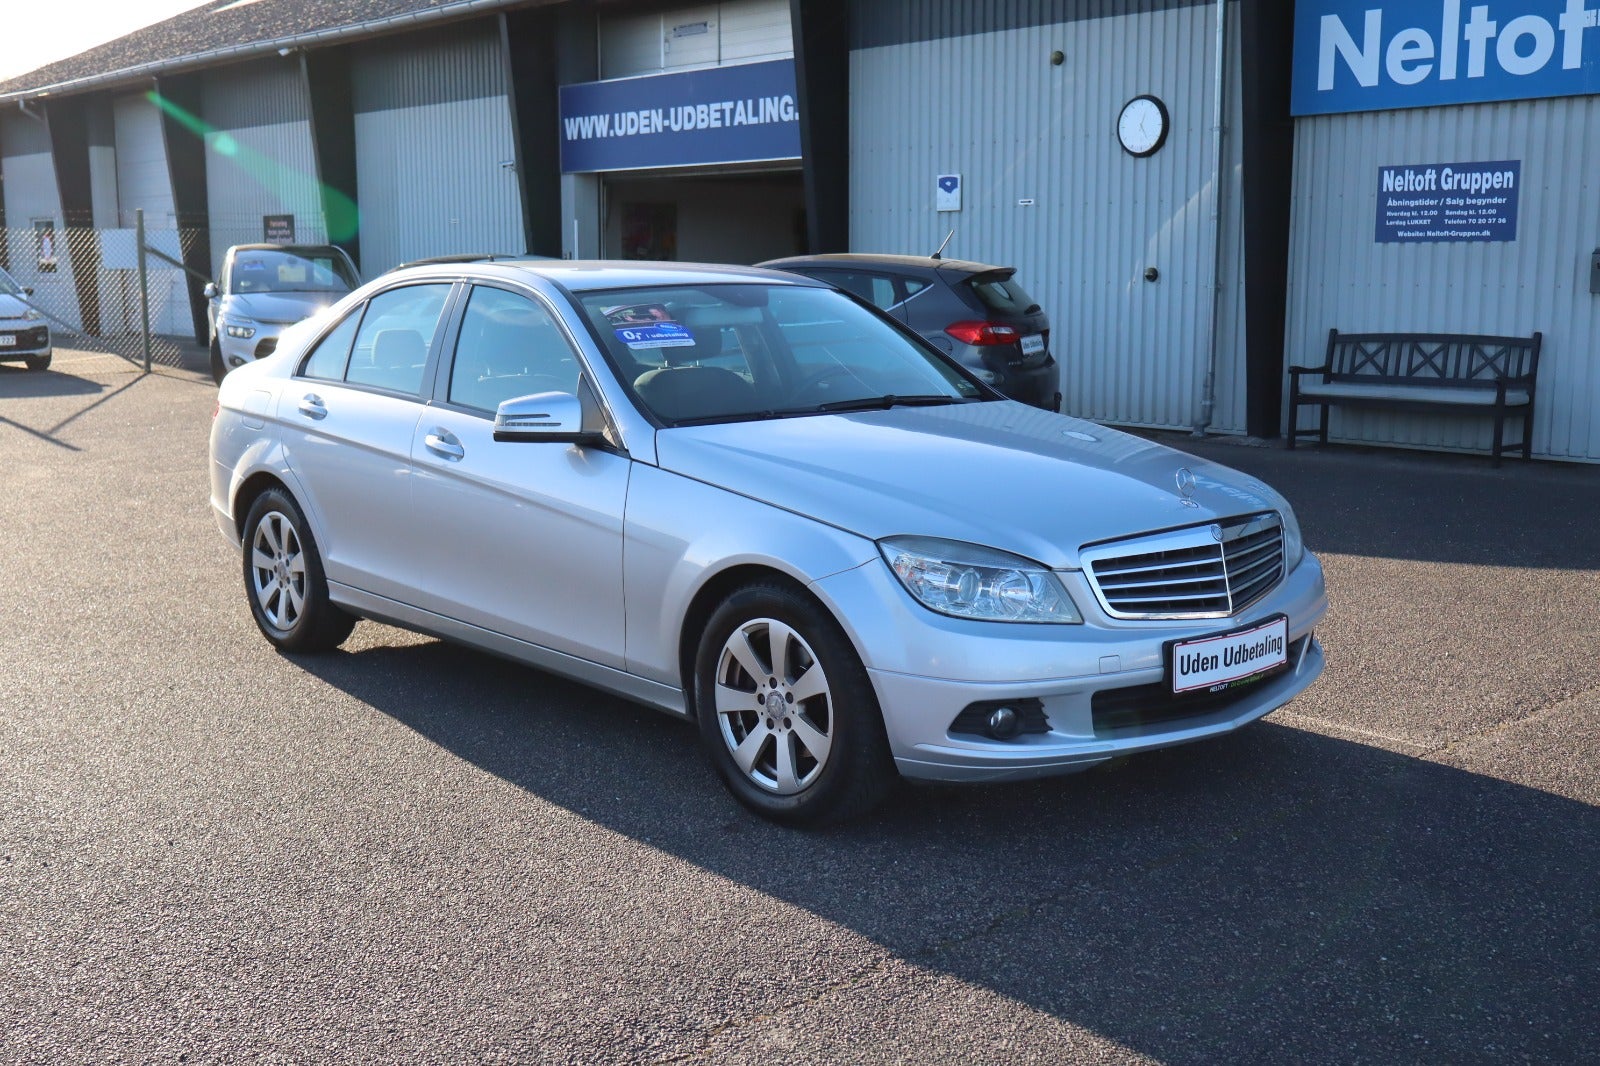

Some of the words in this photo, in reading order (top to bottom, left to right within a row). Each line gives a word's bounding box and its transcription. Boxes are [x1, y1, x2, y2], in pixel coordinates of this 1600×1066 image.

[1317, 0, 1600, 91] Neltof
[1382, 169, 1437, 192] Neltoft
[1441, 167, 1514, 194] Gruppen
[1386, 197, 1438, 207] Åbningstider
[1446, 197, 1464, 206] Salg
[1466, 196, 1507, 205] begynder
[1180, 652, 1219, 676] Uden
[1223, 635, 1283, 667] Udbetaling
